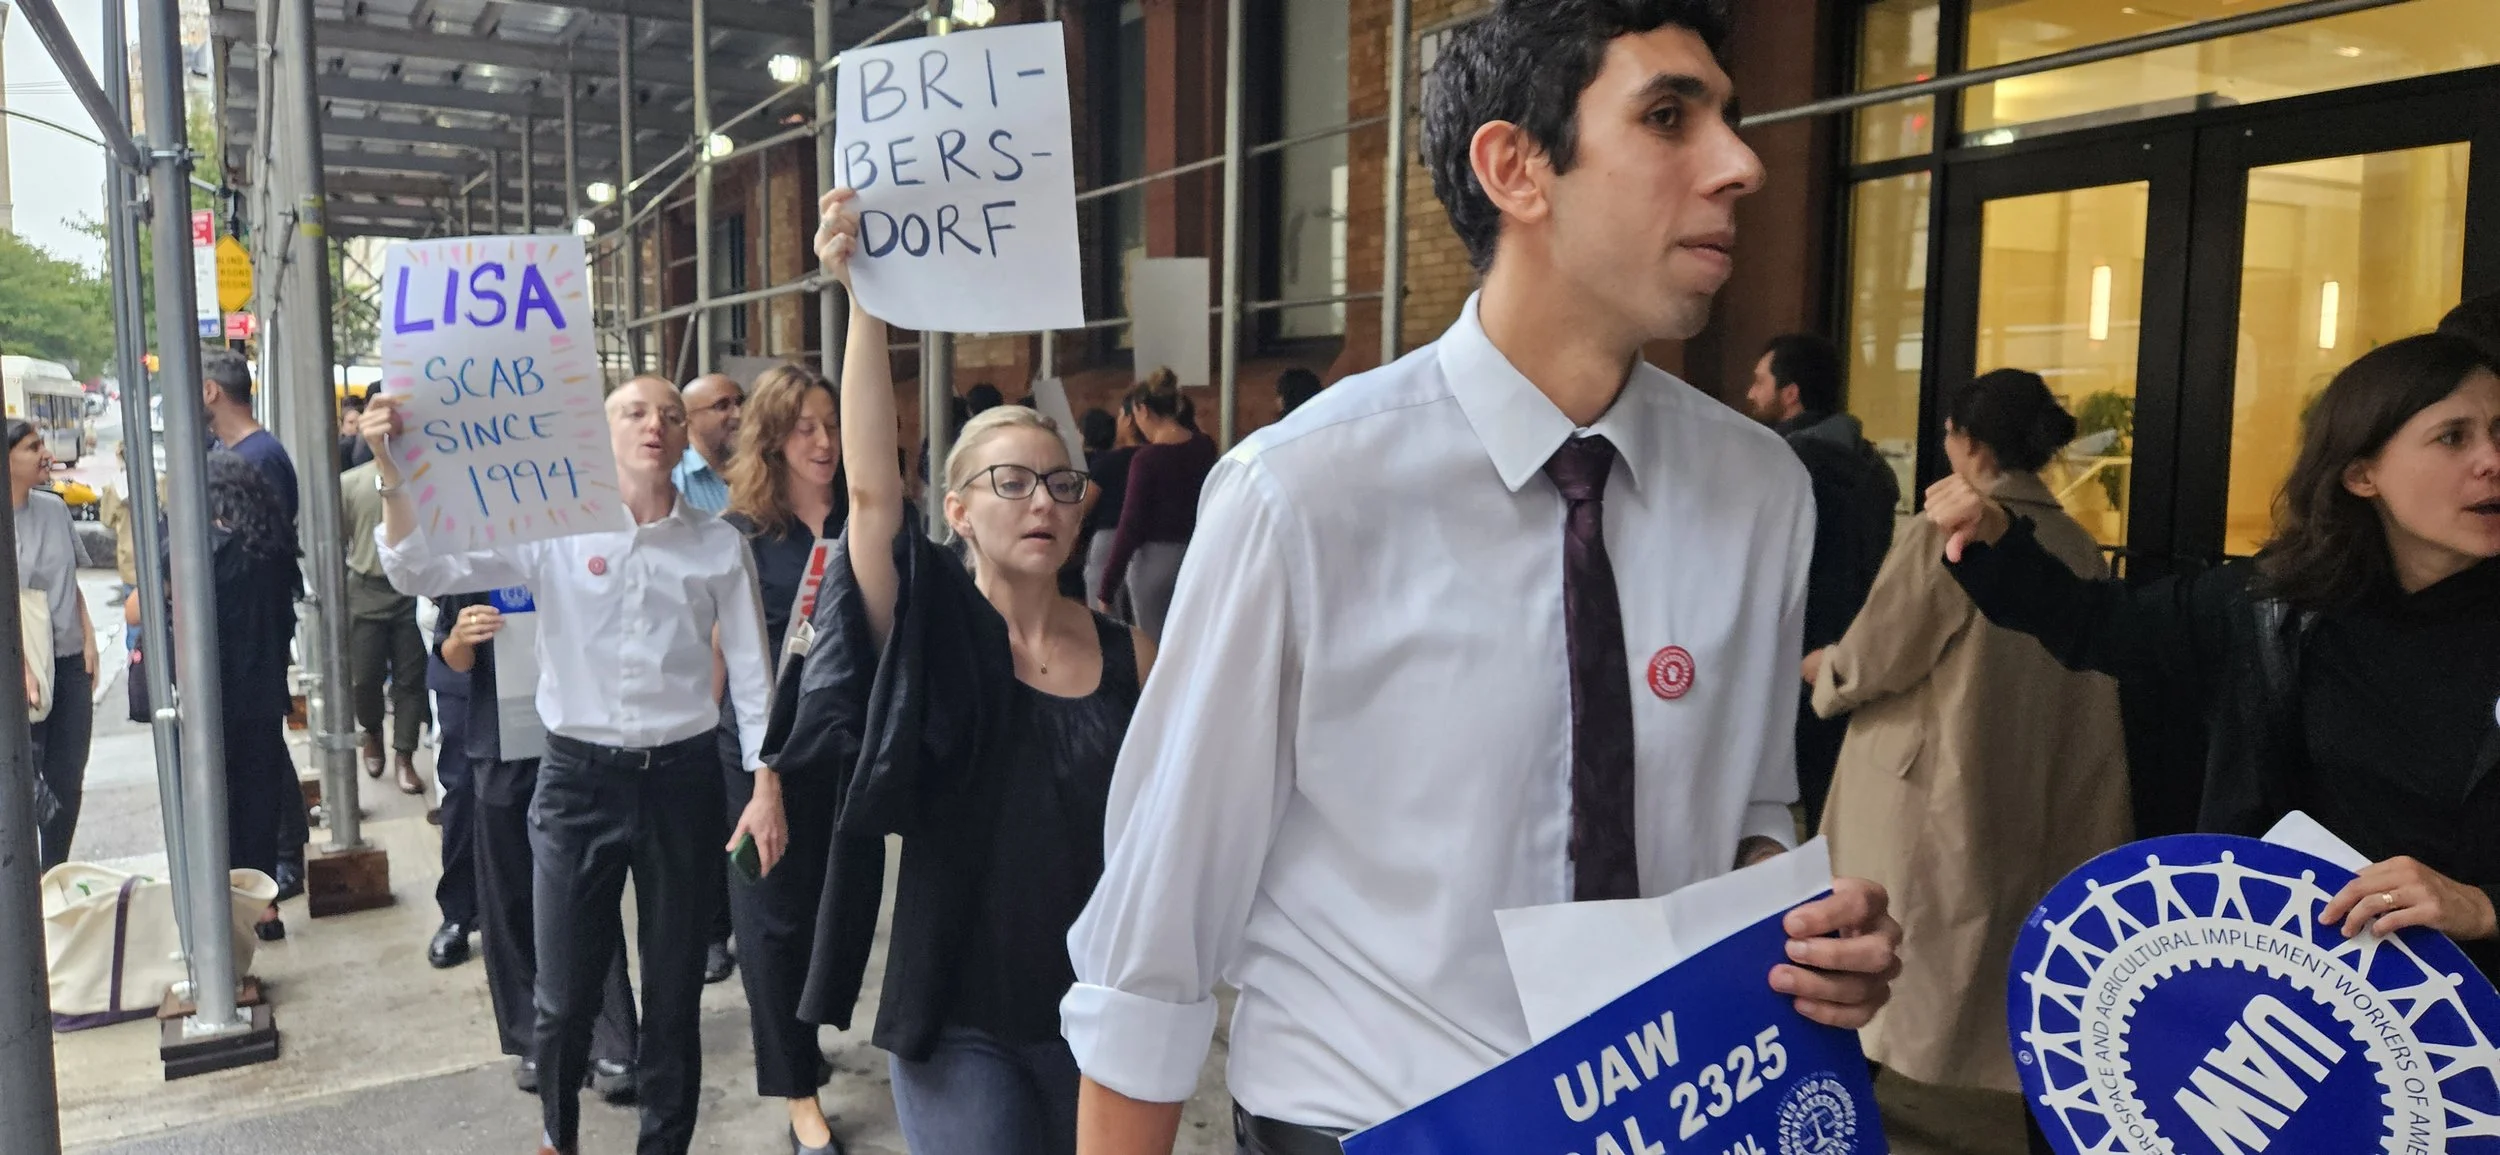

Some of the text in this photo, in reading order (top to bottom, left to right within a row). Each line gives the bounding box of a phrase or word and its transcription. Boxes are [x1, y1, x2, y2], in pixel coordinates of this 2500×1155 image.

[860, 49, 1045, 123] BRI-
[845, 129, 1052, 191] BERS-
[860, 200, 1017, 258] DORF
[394, 261, 567, 335] LISA
[425, 356, 545, 406] SCAB
[424, 410, 564, 455] SINCE
[468, 456, 590, 517] 1994
[2096, 930, 2199, 1019] AGRICULTURAL
[2201, 928, 2335, 979] IMPLEMENT
[2093, 1020, 2111, 1063] AND
[2335, 974, 2418, 1072] WORKERS
[1553, 1010, 1680, 1122] UAW
[1669, 1024, 1787, 1141] 2325
[2173, 993, 2347, 1155] UAW
[2404, 1077, 2430, 1107] OF
